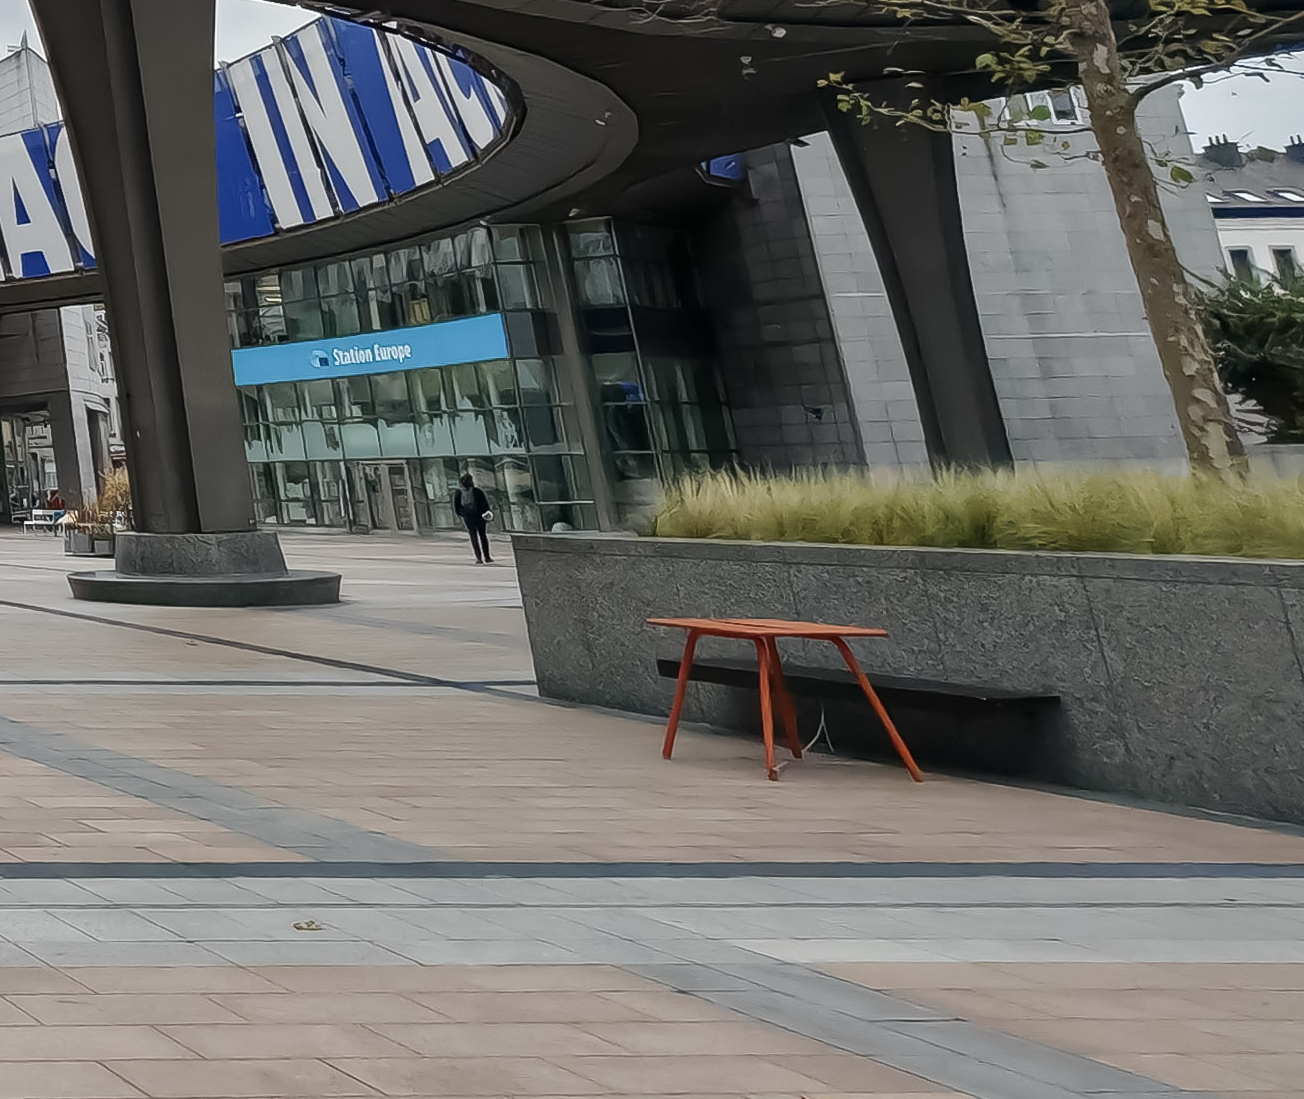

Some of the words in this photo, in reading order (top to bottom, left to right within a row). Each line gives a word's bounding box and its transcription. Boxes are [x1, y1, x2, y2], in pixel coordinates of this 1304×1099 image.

[228, 22, 380, 231] IN
[333, 346, 373, 366] Station
[373, 343, 412, 364] Europe
